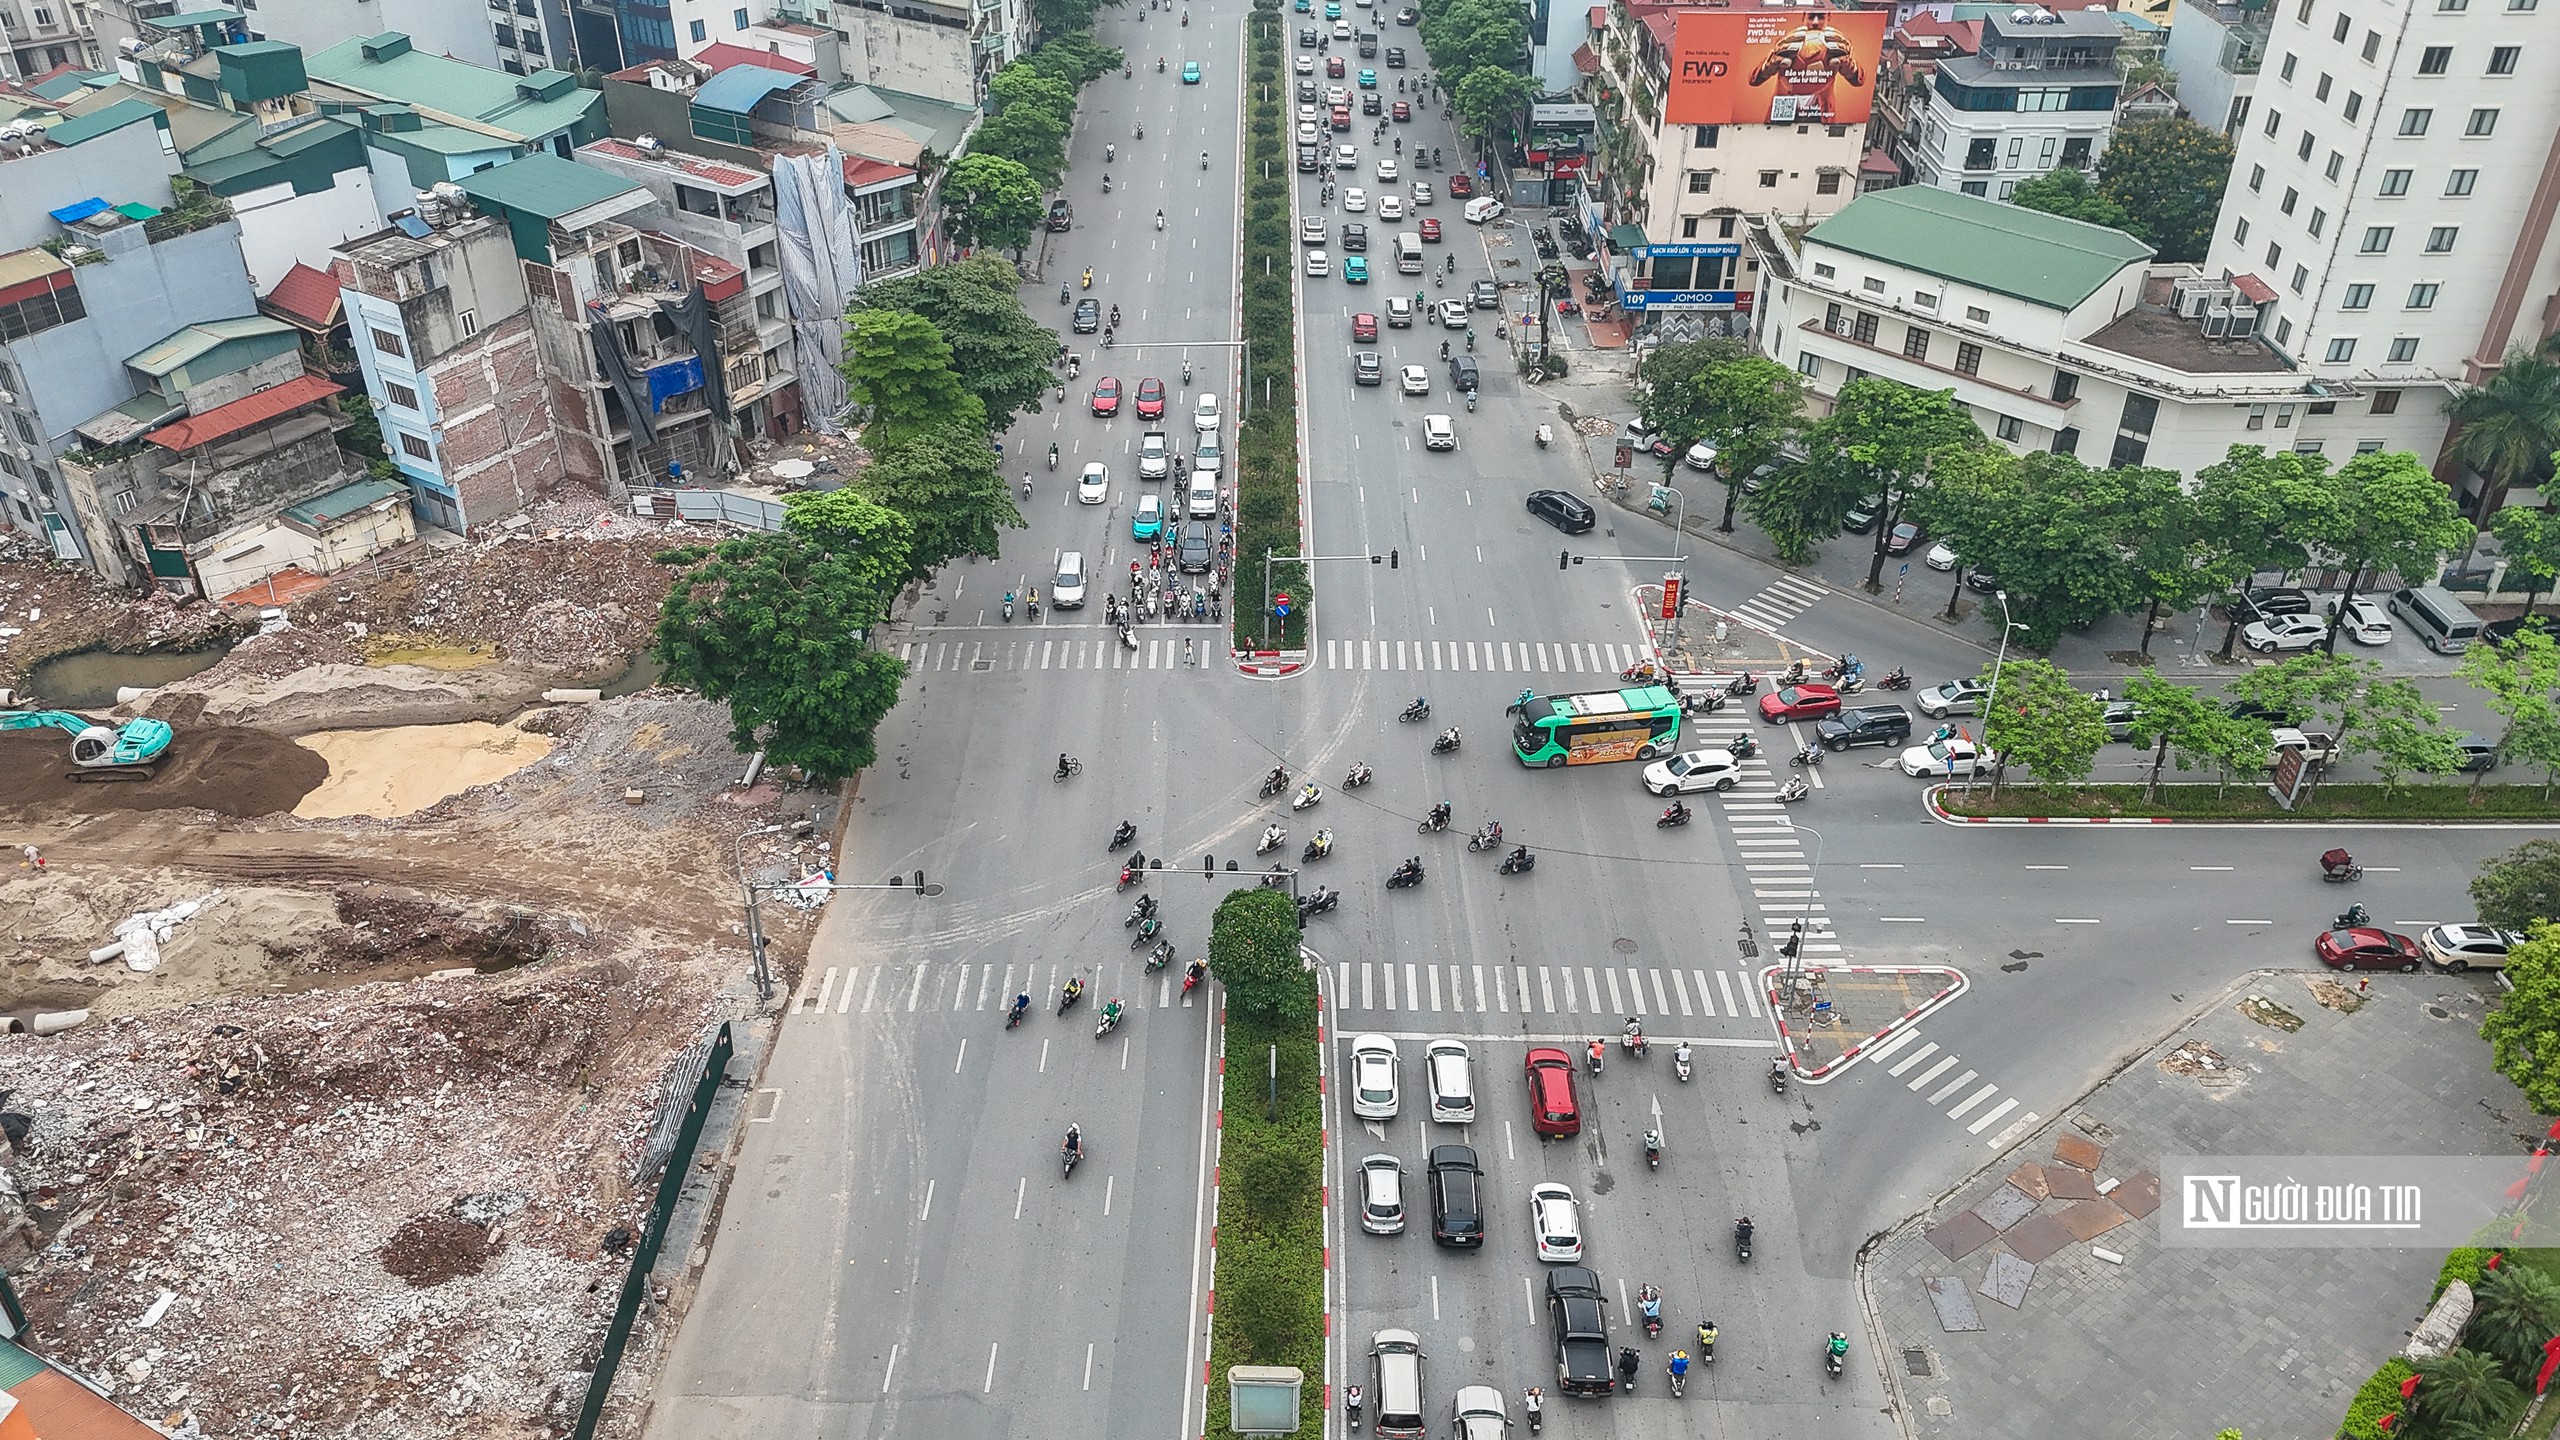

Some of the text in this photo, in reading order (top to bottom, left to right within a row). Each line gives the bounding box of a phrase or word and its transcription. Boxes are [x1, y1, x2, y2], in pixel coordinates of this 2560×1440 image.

[1683, 61, 1728, 77] FWD
[1785, 68, 1797, 77] Bảo
[1797, 69, 1806, 78] vệ
[1818, 69, 1833, 78] hoạt
[1788, 76, 1801, 84] đầu
[1652, 247, 1666, 255] GẠCH
[1666, 245, 1679, 254] KHỔ
[1692, 247, 1707, 256] GẠCH
[1626, 294, 1645, 304] 109
[1671, 294, 1713, 303] JOMOO
